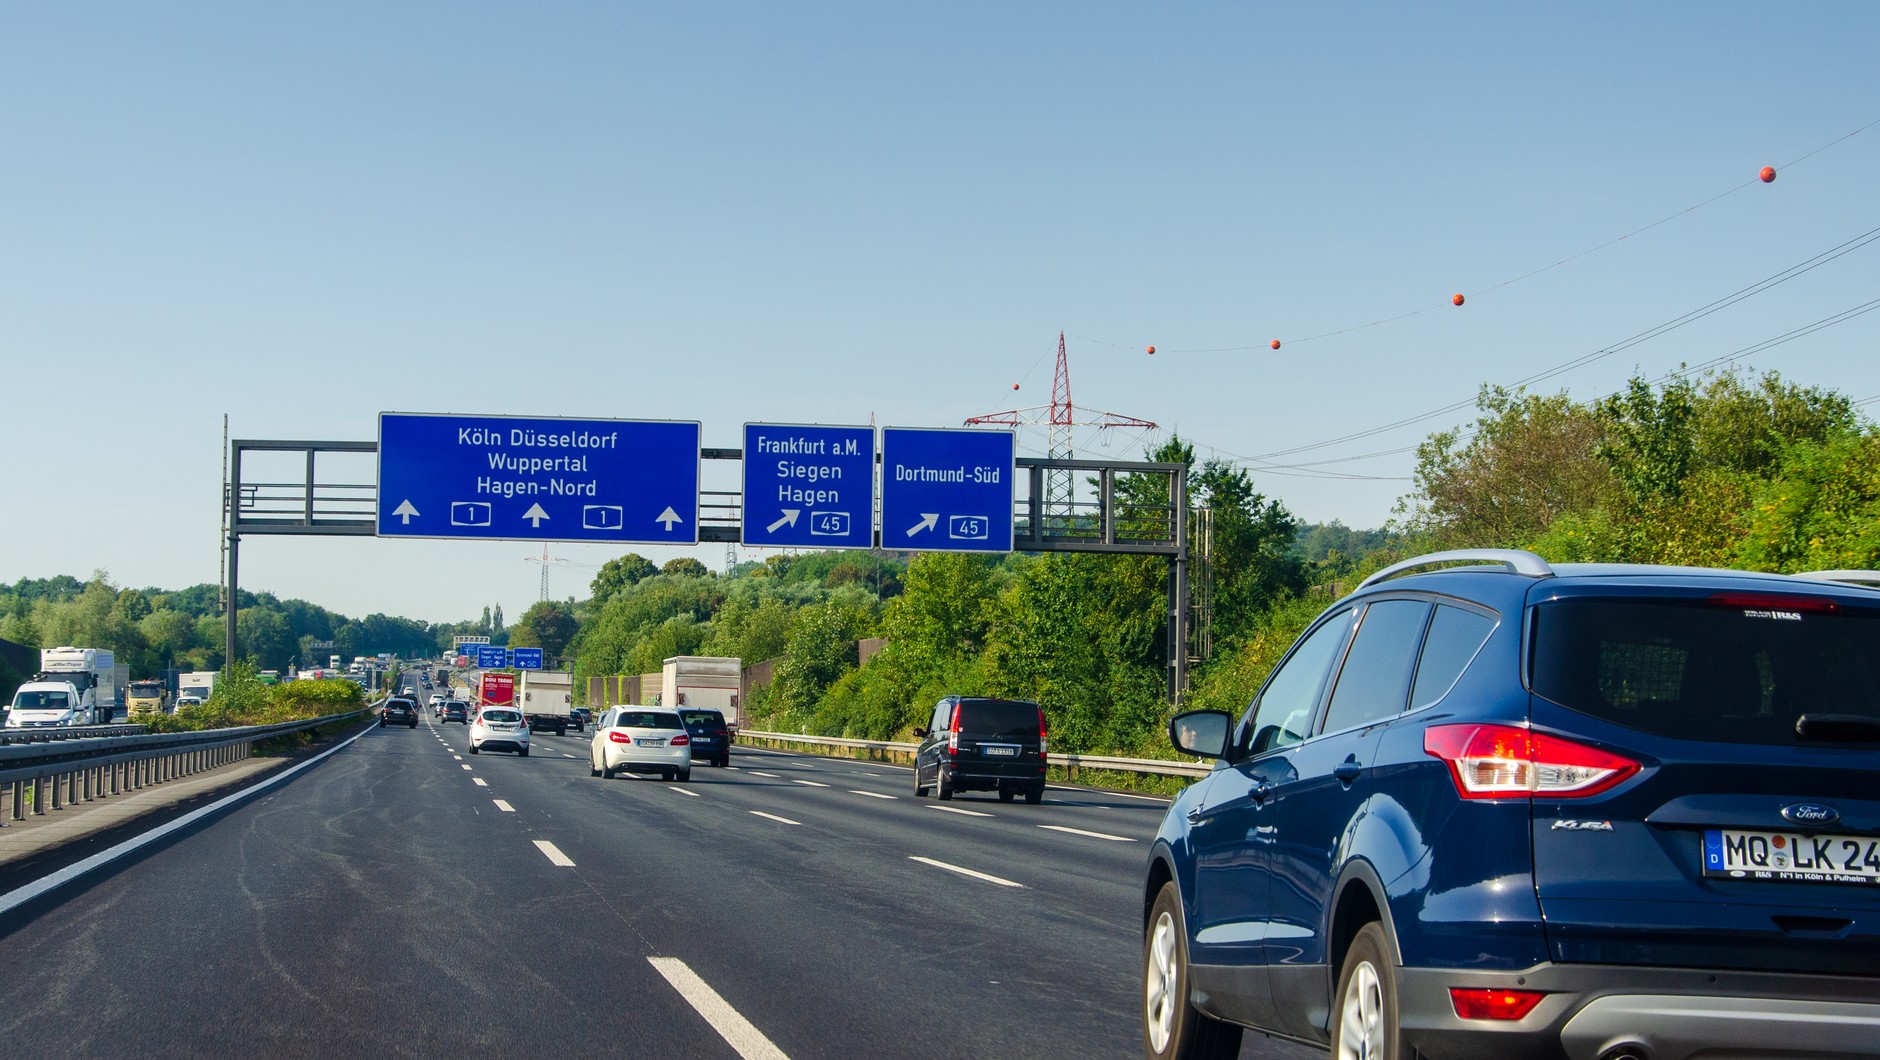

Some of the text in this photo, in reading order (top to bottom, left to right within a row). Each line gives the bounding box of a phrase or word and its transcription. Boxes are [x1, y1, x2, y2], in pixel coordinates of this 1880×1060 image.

[458, 428, 617, 449] Köln Düsseldorf
[758, 436, 861, 456] Frankfurt a.M.
[488, 453, 588, 474] Wuppertal
[777, 461, 842, 482] Siegen
[896, 464, 1000, 484] Dortmund-Süd
[477, 476, 597, 498] Hagen-Nord
[778, 485, 839, 507] Hagen
[467, 506, 474, 521] 1
[599, 510, 606, 525] 1
[820, 516, 840, 531] 45
[959, 520, 979, 535] 45
[1796, 805, 1827, 820] Ford
[1710, 853, 1719, 864] D
[1725, 834, 1770, 867] MQ
[1791, 838, 1835, 870] LK
[1795, 872, 1803, 880] in
[1804, 872, 1824, 881] Köln
[1833, 874, 1867, 883] Pulheim
